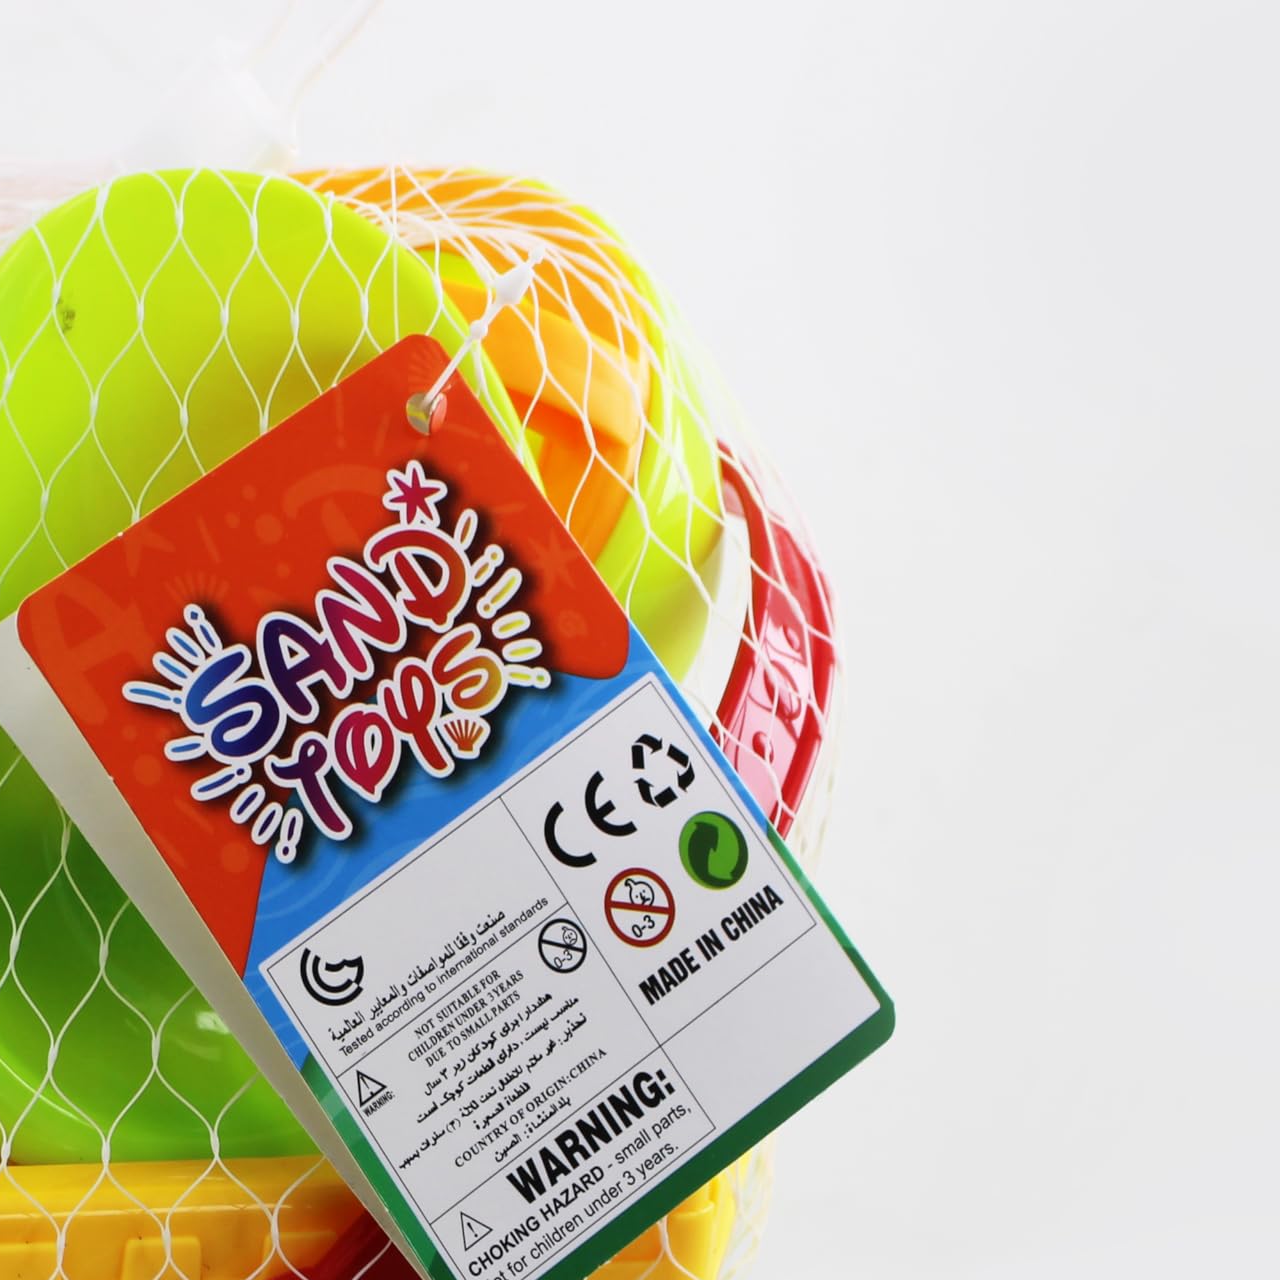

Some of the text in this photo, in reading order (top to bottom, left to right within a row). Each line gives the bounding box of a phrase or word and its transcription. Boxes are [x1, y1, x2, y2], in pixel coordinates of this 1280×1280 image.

[180, 523, 472, 766] SAND
[265, 623, 509, 841] TOYS
[543, 770, 638, 868] CE
[406, 942, 456, 986] للمواصفات
[475, 910, 505, 936] صنعت
[630, 913, 655, 938] 0-3
[637, 884, 784, 1006] MADE IN CHINA
[338, 897, 548, 1056] Tested according to international standards
[369, 983, 408, 1021] والمعايير
[407, 1020, 456, 1062] CHILDREN
[453, 997, 488, 1026] UNDER
[491, 969, 524, 997] YEARS
[413, 969, 501, 1039] NOT SUITABLE FOR
[327, 1010, 365, 1042] العالمية
[424, 989, 520, 1067] DUE TO SMALL PARTS
[362, 1090, 393, 1117] WARNING:
[454, 1119, 509, 1167] COUNTRY
[508, 1107, 524, 1125] OF
[504, 1068, 676, 1204] WARNING:
[467, 1215, 541, 1277] CHOKING
[538, 1165, 604, 1222] HAZARD
[614, 1127, 652, 1164] small
[650, 1104, 691, 1139] parts,
[506, 1254, 528, 1277] for
[529, 1213, 584, 1259] children
[583, 1180, 623, 1217] under
[621, 1169, 636, 1186] 3
[634, 1142, 678, 1180] years.
